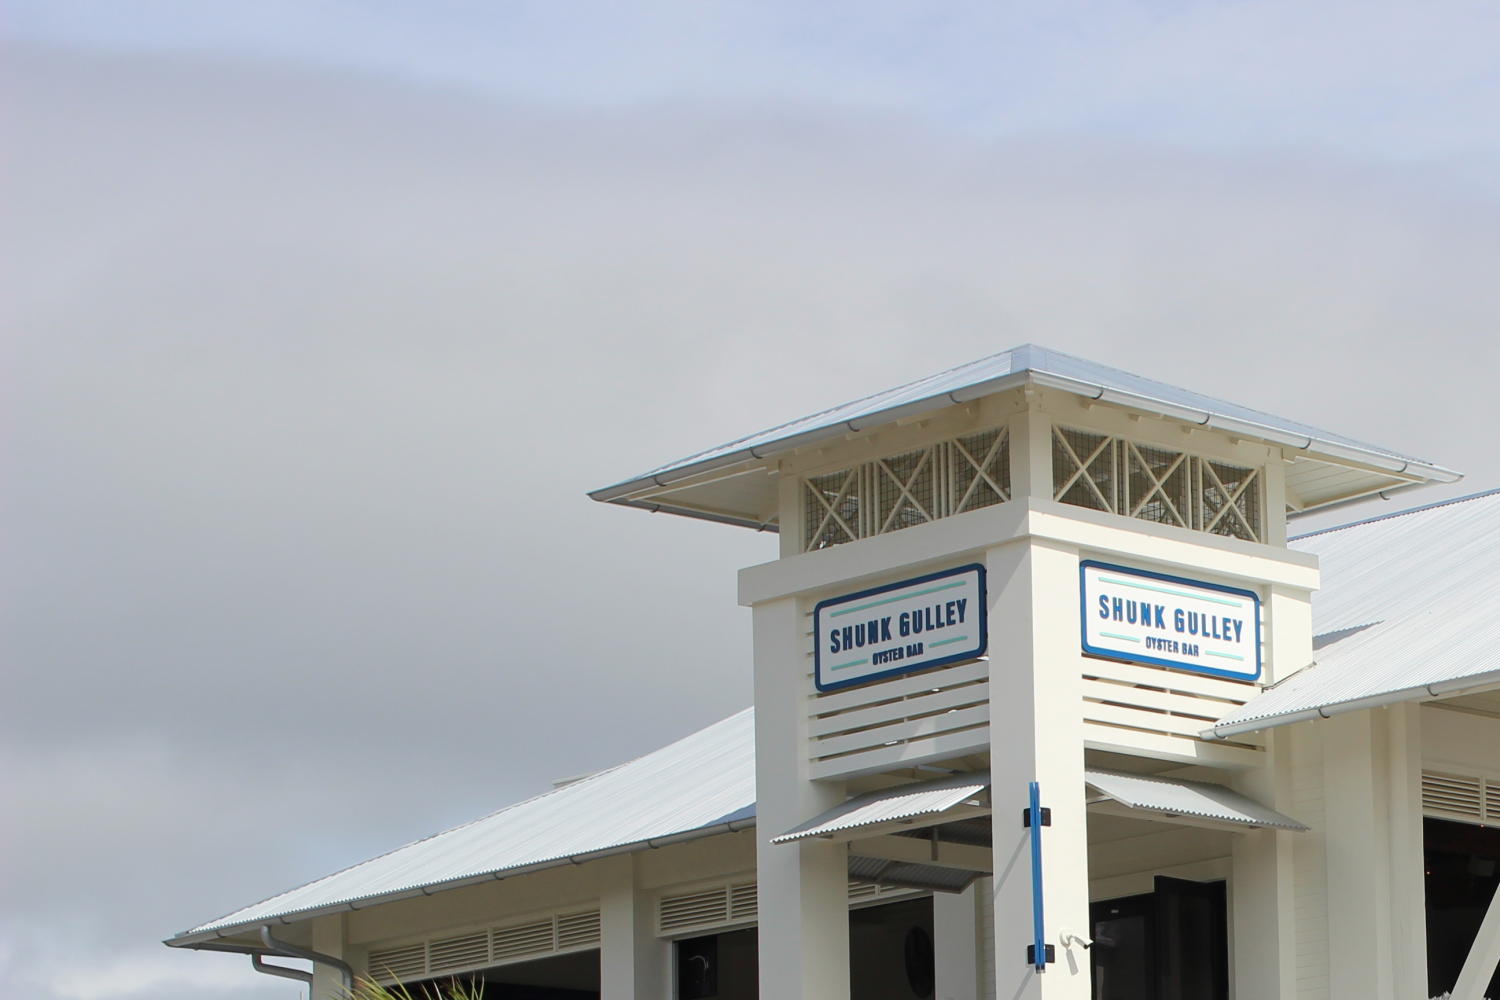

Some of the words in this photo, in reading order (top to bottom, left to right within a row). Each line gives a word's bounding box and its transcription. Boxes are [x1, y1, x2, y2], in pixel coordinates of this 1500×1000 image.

[830, 616, 892, 654] SHUNK
[899, 598, 968, 637] GULLEY
[1099, 594, 1166, 630] SHUNK
[1174, 608, 1243, 643] GULLEY
[872, 646, 904, 665] OYSTER
[906, 642, 924, 658] BAR
[1145, 636, 1179, 653] OYSTER
[1181, 642, 1200, 657] BAR
